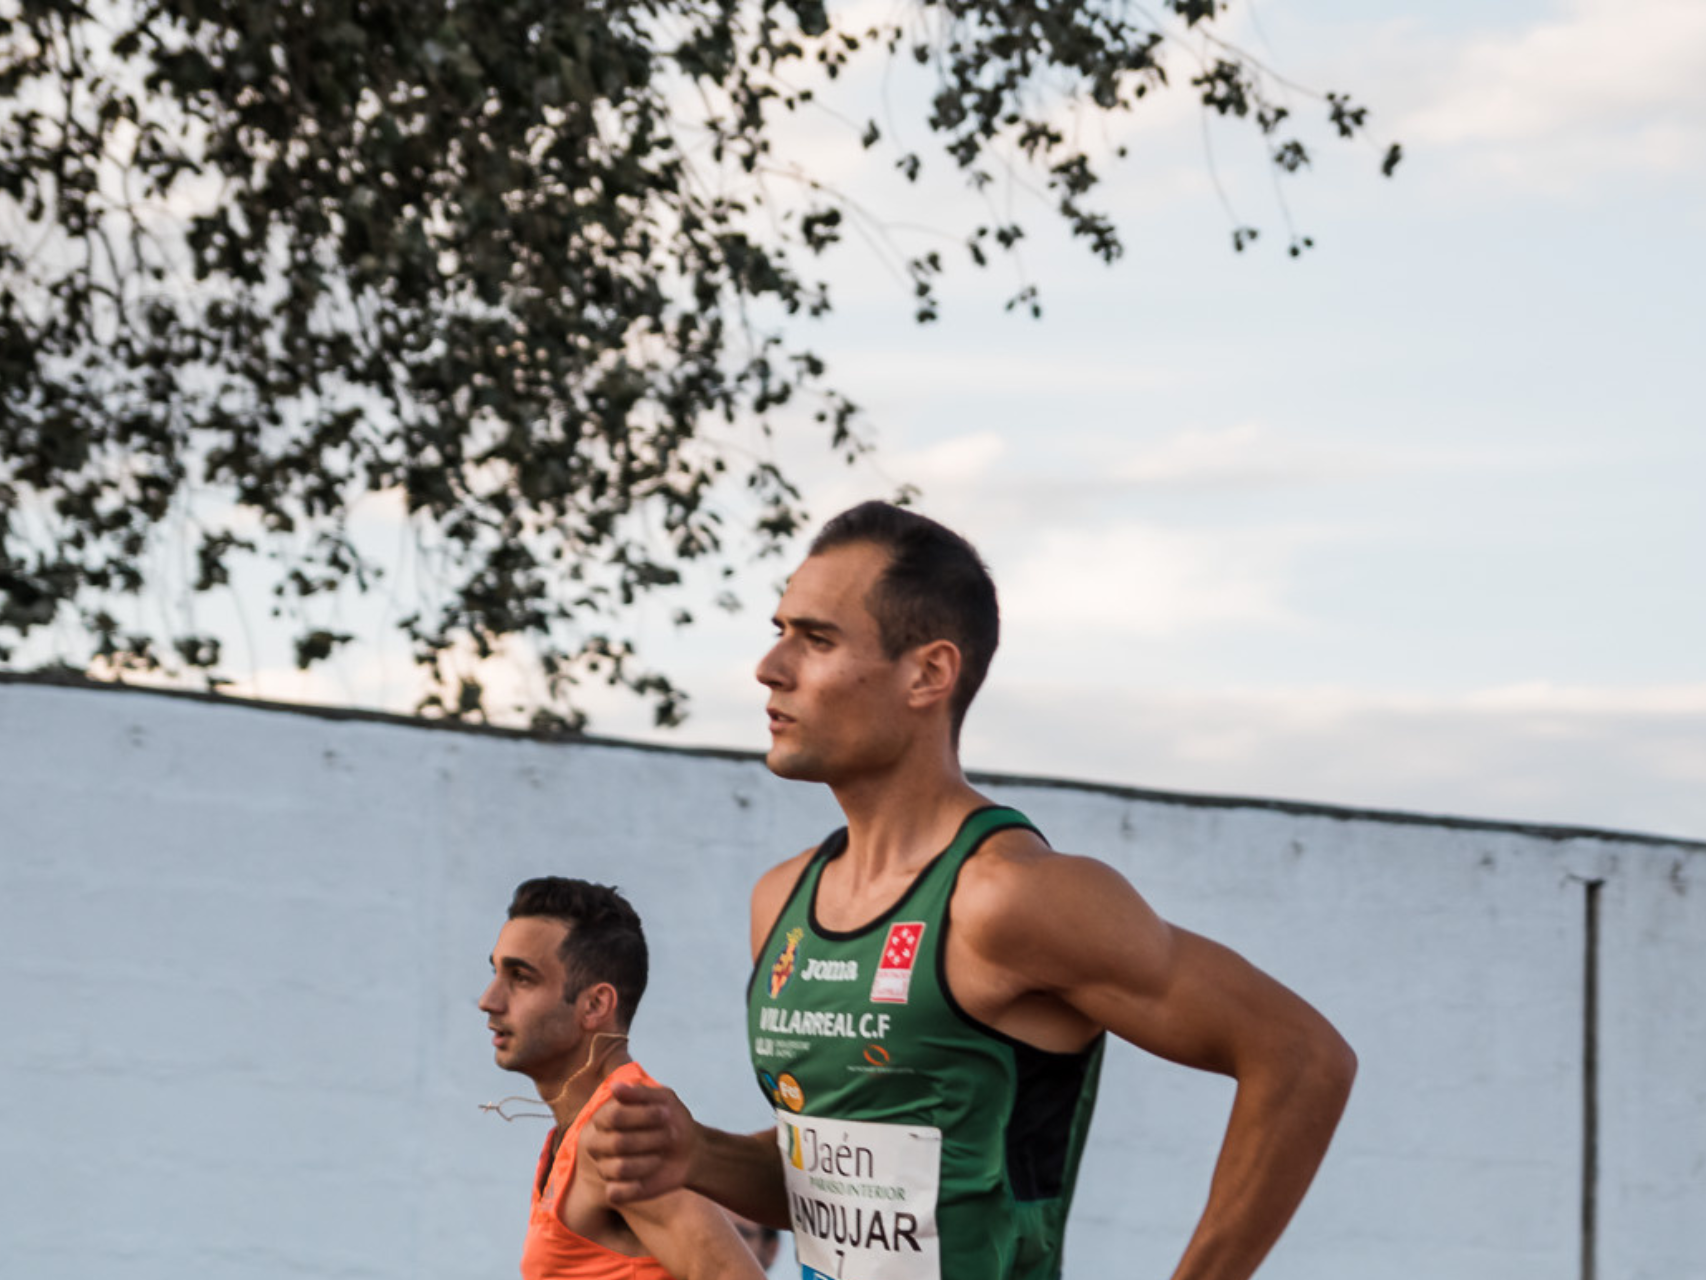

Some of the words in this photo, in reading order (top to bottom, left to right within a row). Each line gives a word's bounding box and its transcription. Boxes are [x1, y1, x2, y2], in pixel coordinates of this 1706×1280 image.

[760, 1007, 857, 1038] VILLARREAL
[803, 1128, 873, 1178] Jaén
[836, 1249, 845, 1279] 7
